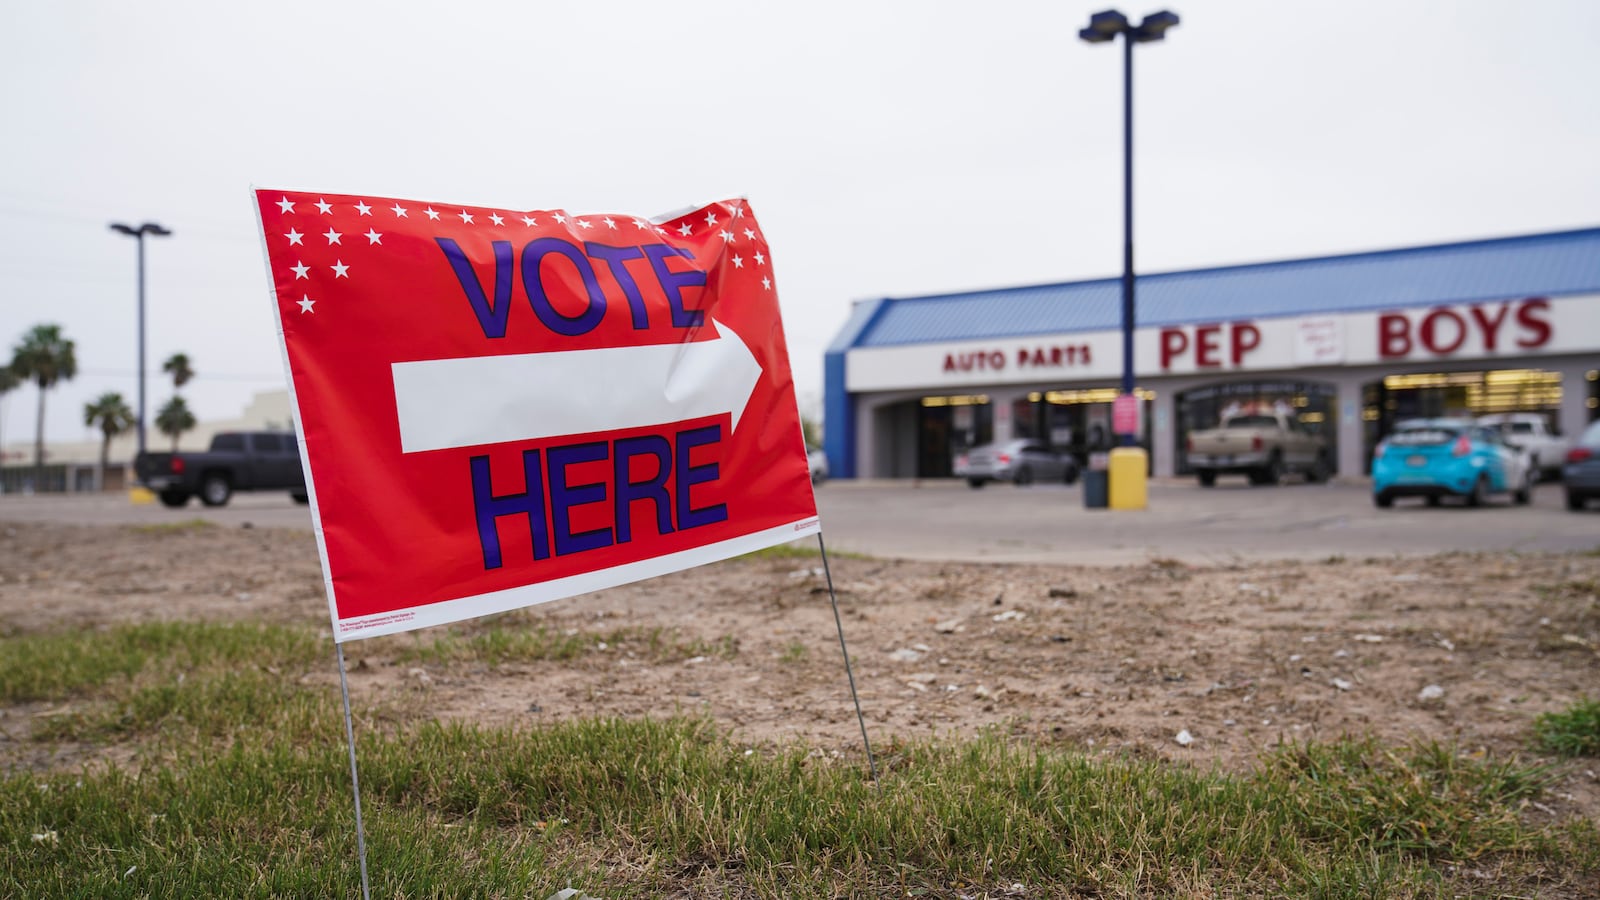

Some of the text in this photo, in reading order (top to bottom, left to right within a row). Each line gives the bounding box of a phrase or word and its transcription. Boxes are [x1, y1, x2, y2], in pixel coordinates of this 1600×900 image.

[436, 238, 707, 338] VOTE
[944, 345, 1091, 372] AUTO PARTS
[1160, 322, 1260, 369] PEP
[1379, 299, 1552, 358] BOYS
[471, 426, 727, 569] HERE
